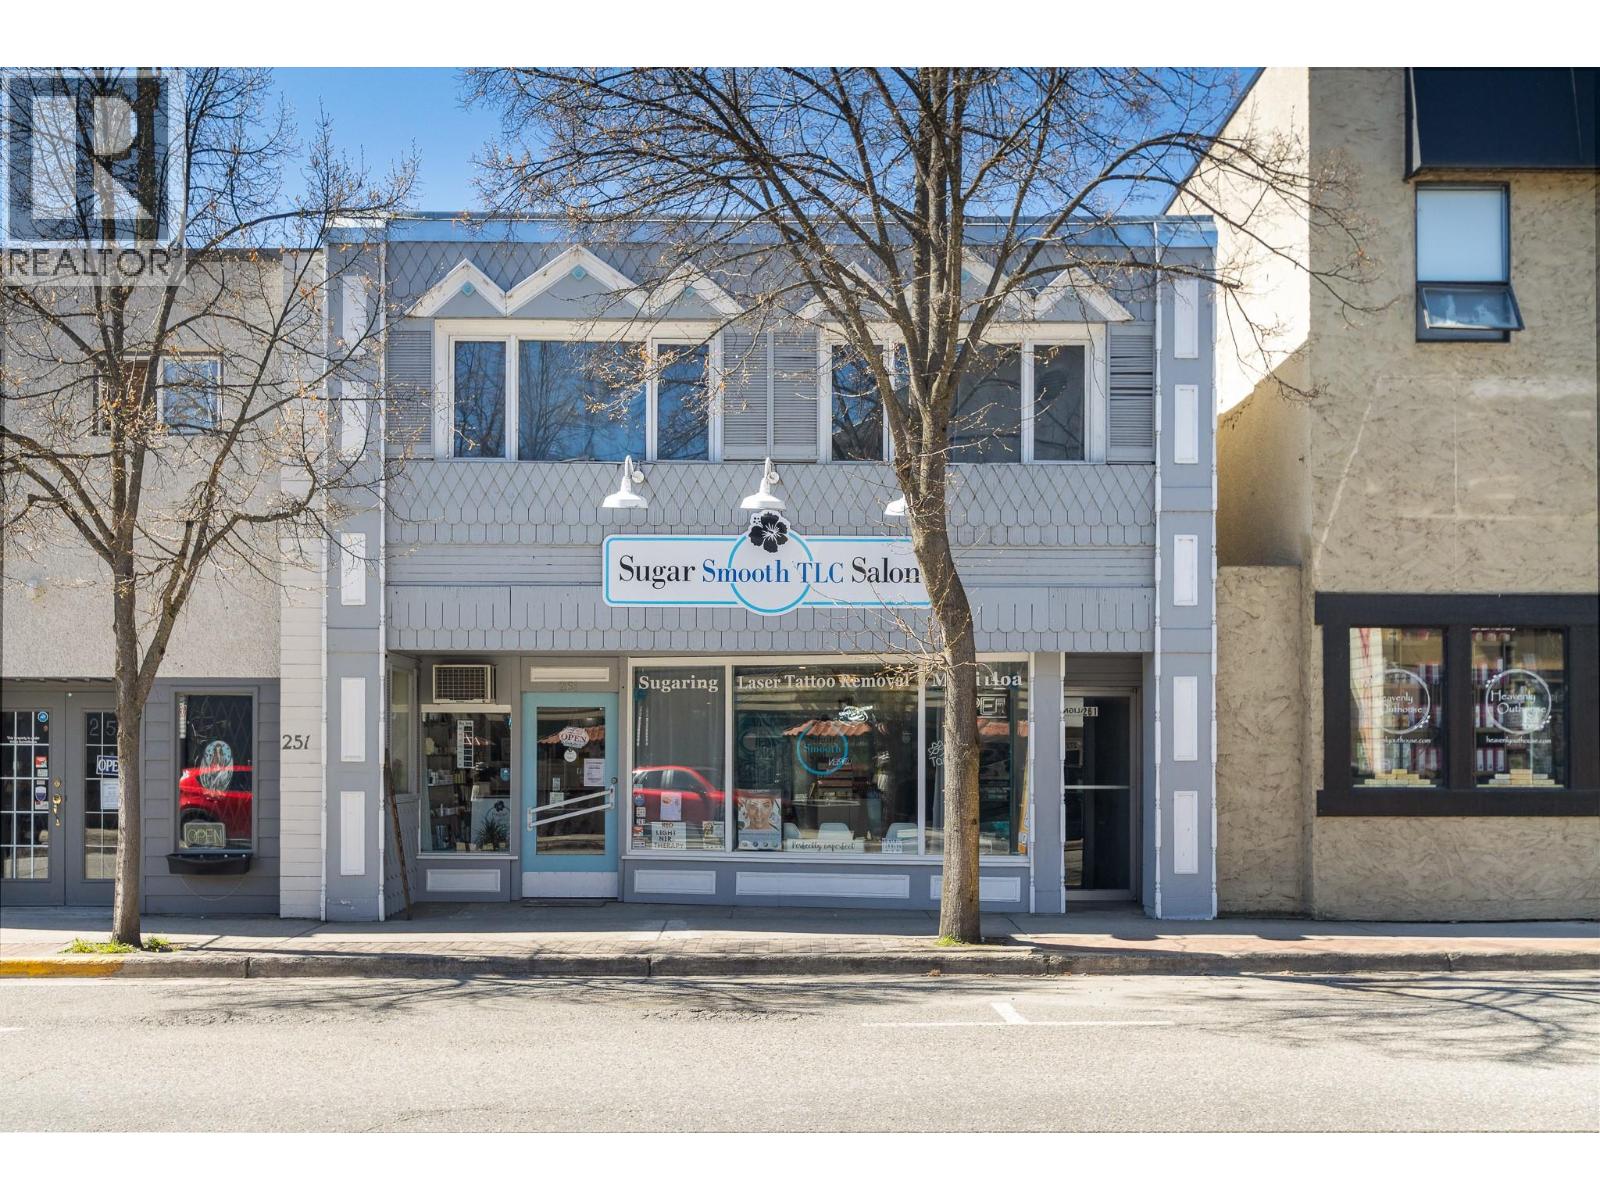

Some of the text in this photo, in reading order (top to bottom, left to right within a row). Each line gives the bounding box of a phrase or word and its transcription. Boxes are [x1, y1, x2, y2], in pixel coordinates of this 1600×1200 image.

[618, 555, 921, 589] Sugar Smooth TLC Salon
[638, 674, 719, 693] Sugaring
[738, 673, 911, 689] Laser Tattoo Removal
[1383, 691, 1413, 704] eavenly
[1491, 690, 1536, 703] Heavenly
[89, 718, 116, 736] 25
[282, 734, 310, 750] 251
[561, 733, 587, 742] OPEN
[98, 759, 119, 772] OPE
[187, 828, 222, 844] OPEN
